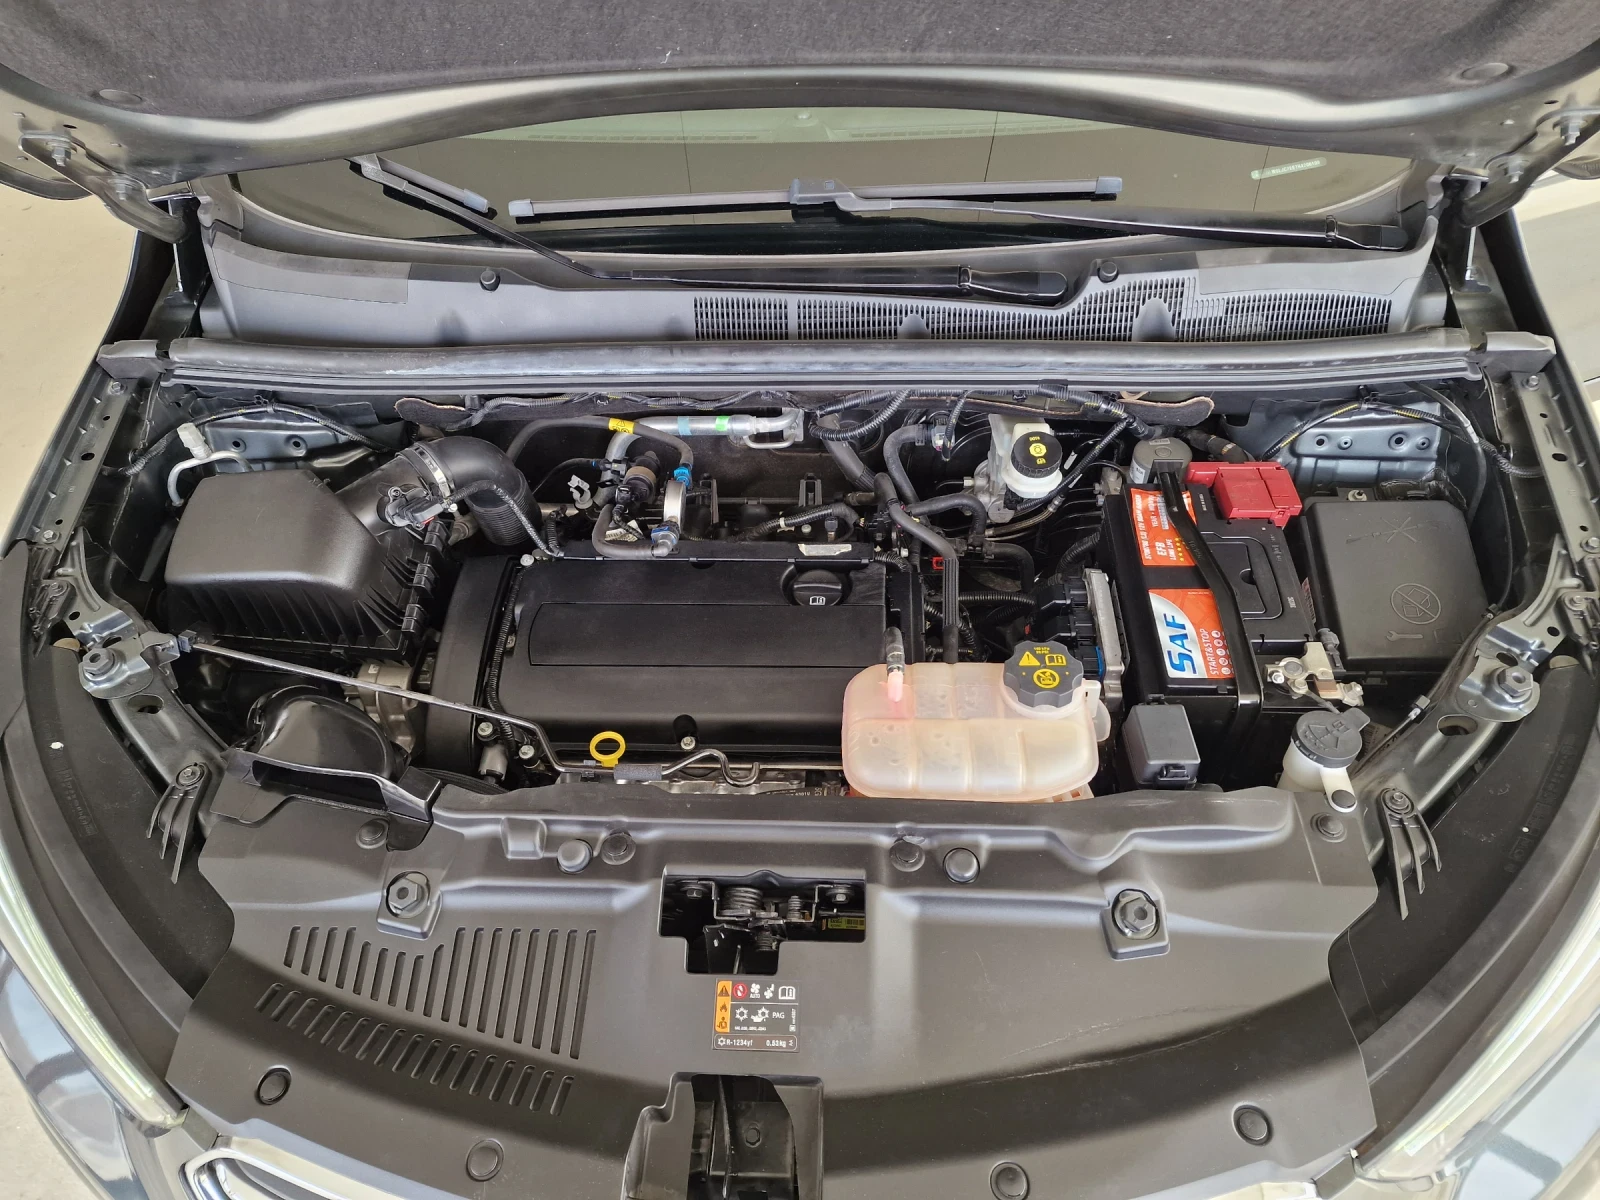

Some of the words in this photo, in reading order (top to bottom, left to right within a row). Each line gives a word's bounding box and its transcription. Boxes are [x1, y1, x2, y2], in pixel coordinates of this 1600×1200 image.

[1155, 541, 1167, 556] EFB
[1165, 538, 1174, 548] LIFE
[1167, 548, 1176, 561] LONG
[1163, 613, 1197, 674] SAF
[1200, 628, 1219, 675] START&STOP
[726, 1039, 753, 1048] R-1234yf
